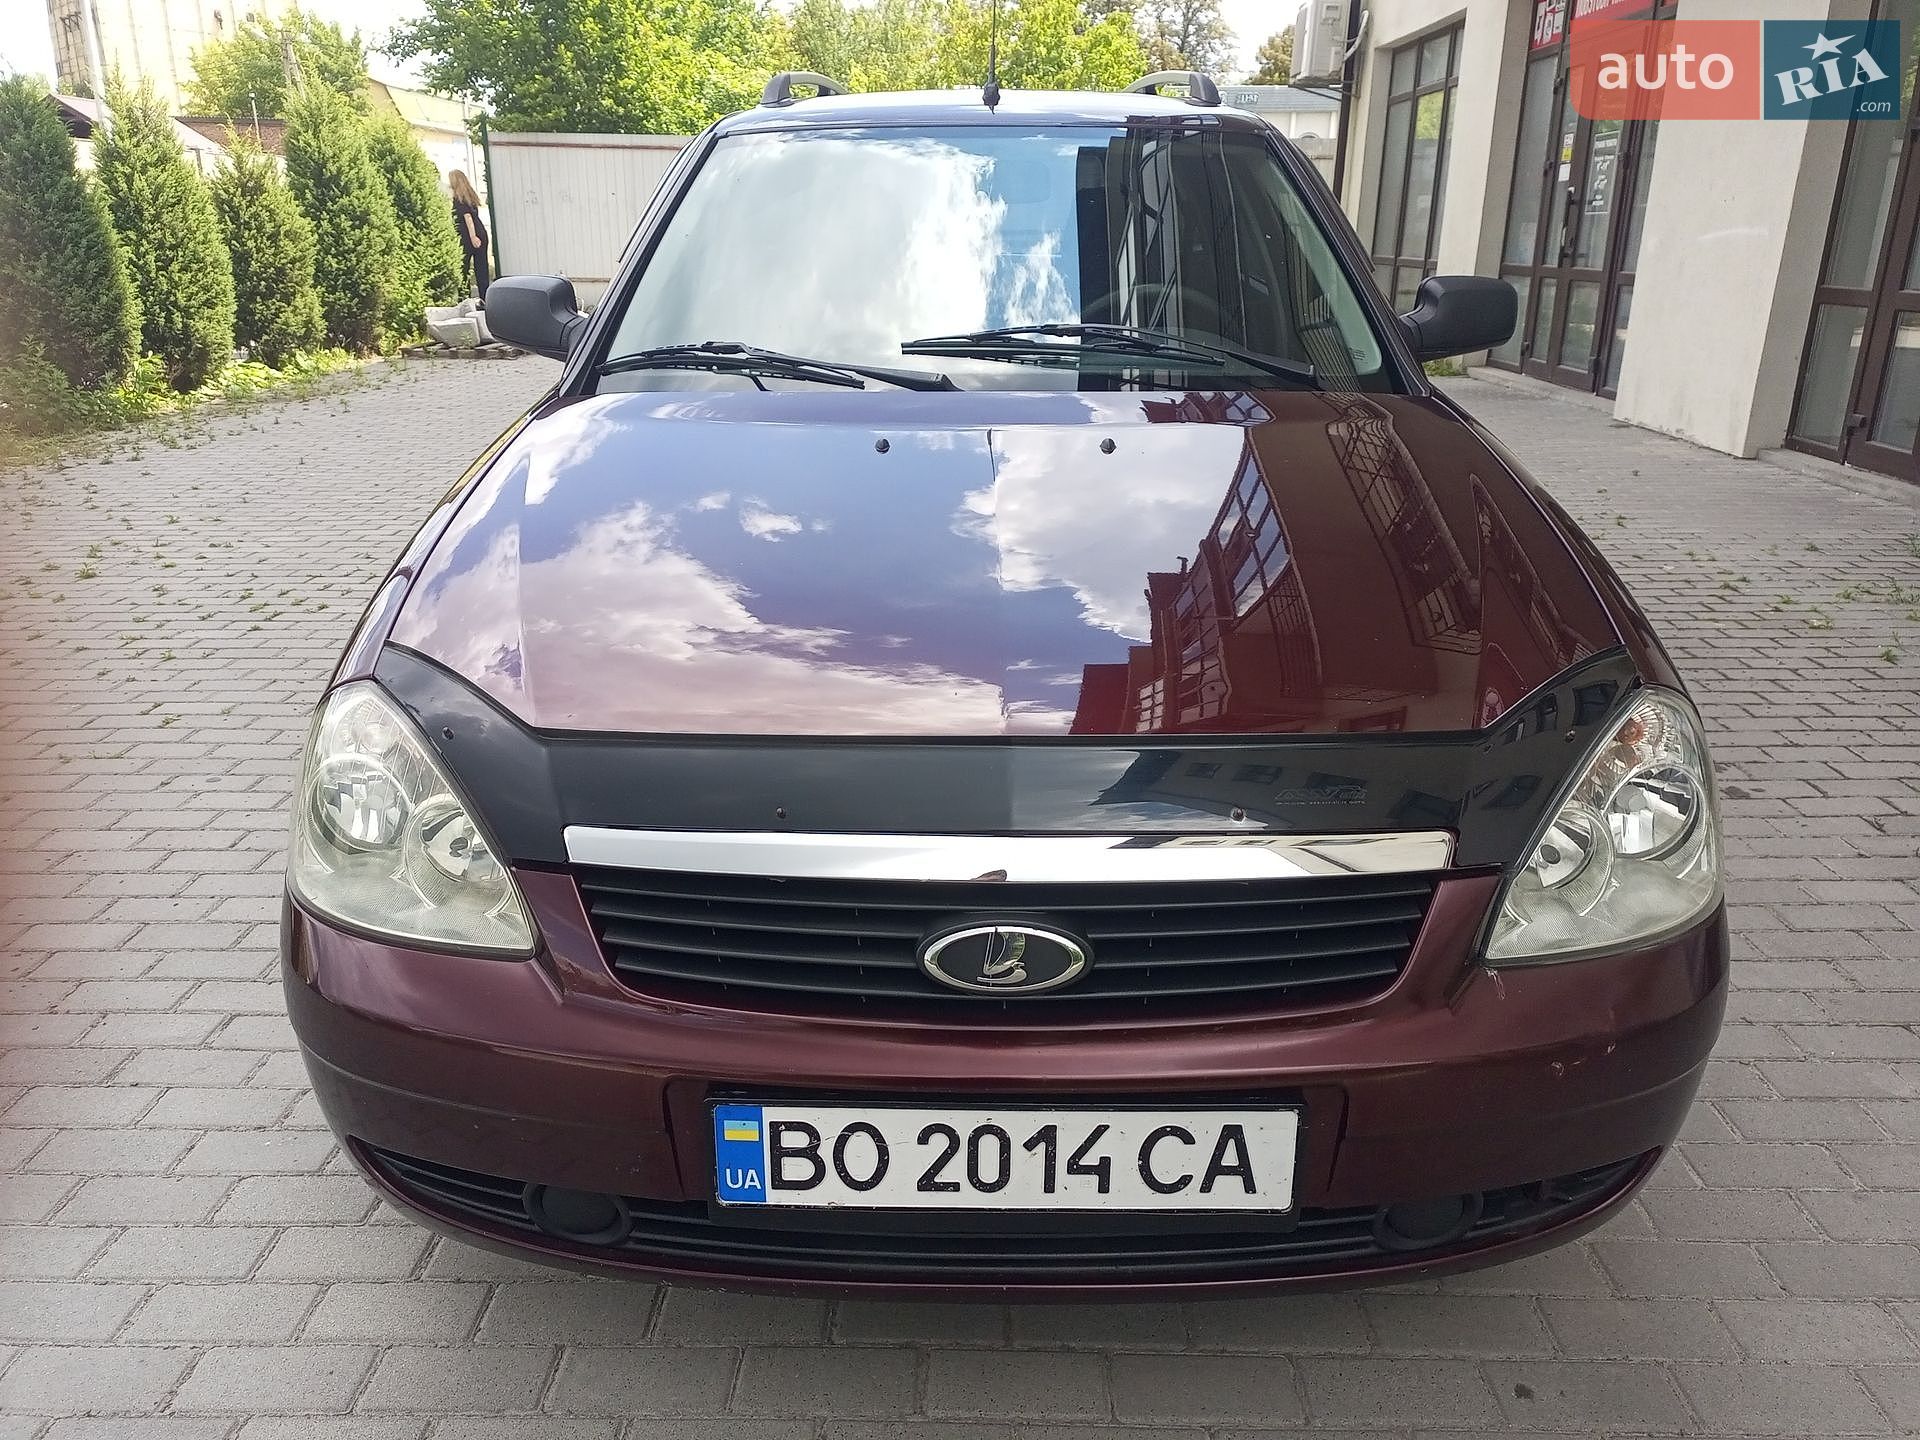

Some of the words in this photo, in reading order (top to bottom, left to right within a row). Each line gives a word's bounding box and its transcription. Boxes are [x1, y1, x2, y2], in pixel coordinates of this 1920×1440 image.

[725, 1168, 762, 1190] UA
[769, 1121, 890, 1192] BO
[916, 1123, 1112, 1194] 2014
[1138, 1125, 1257, 1195] CA
